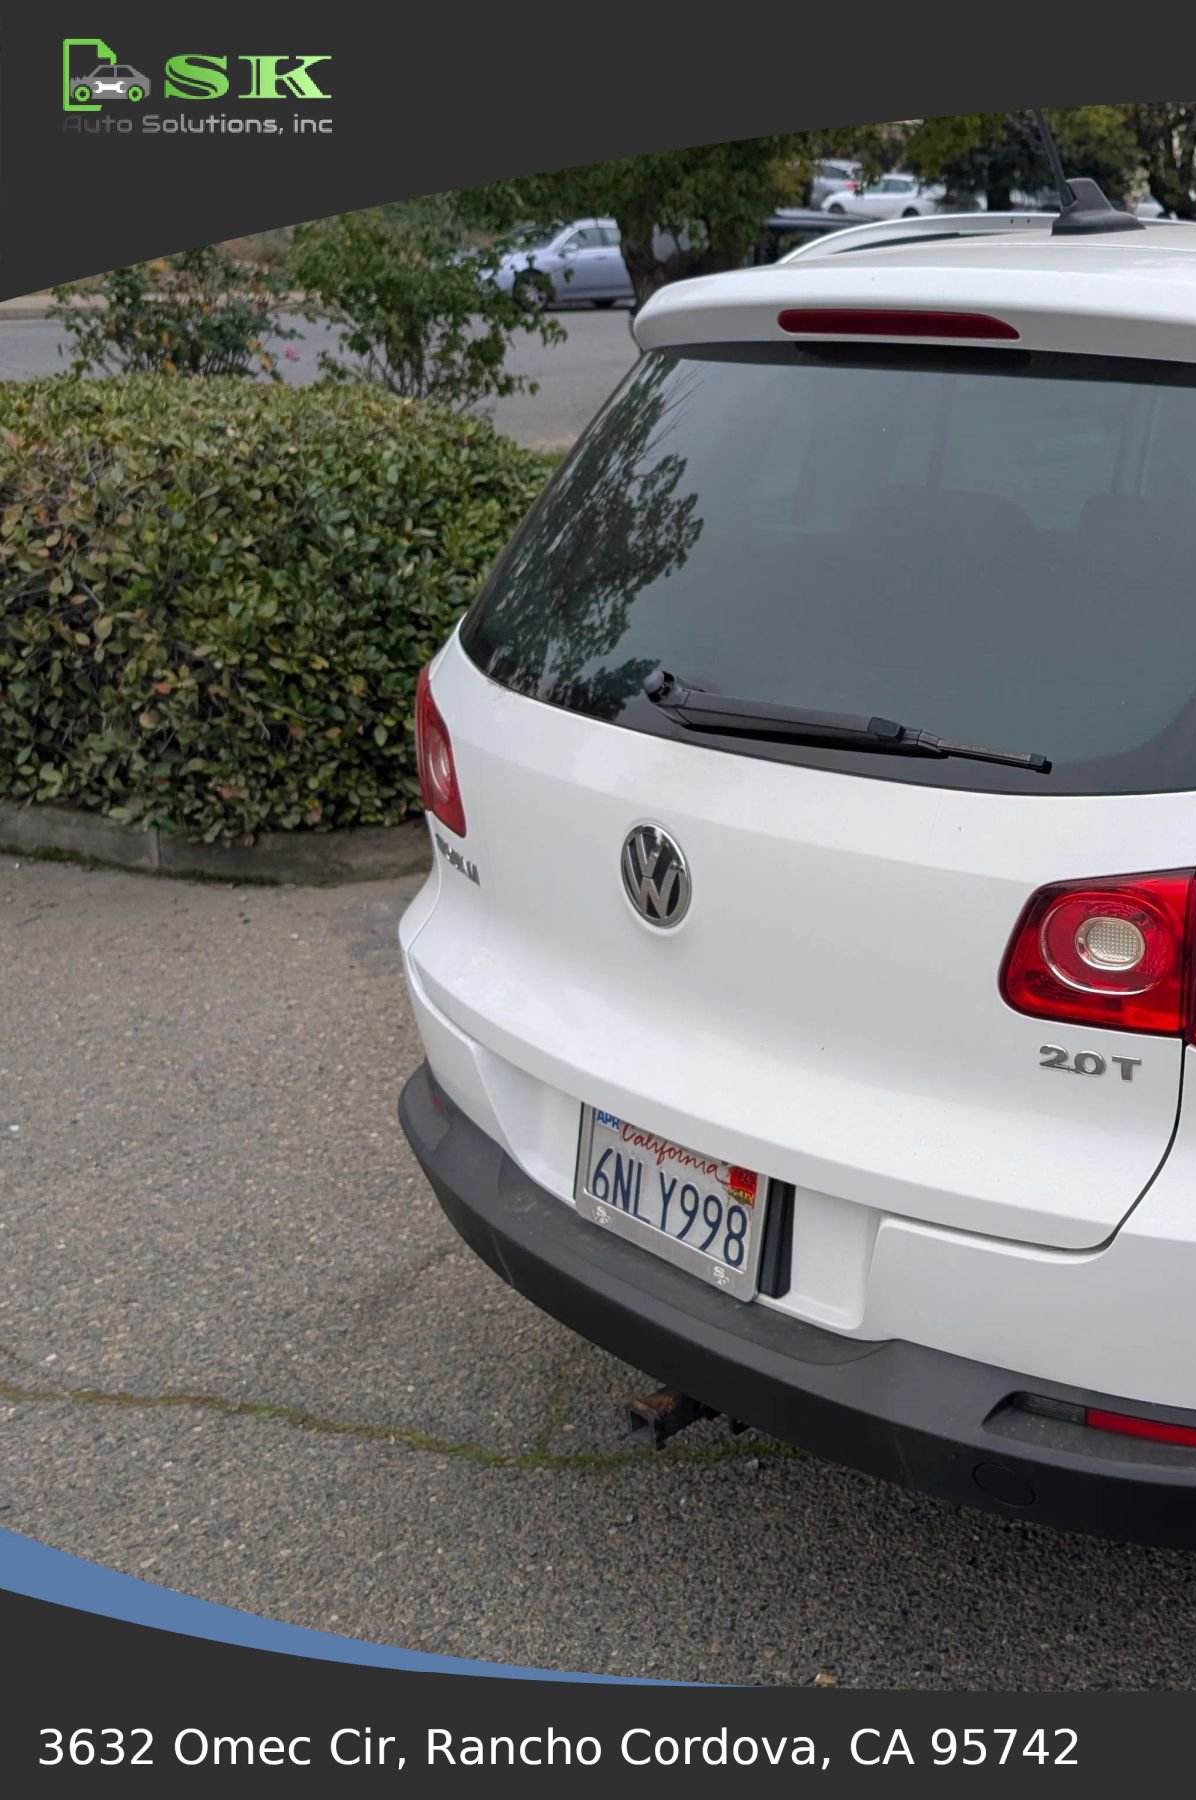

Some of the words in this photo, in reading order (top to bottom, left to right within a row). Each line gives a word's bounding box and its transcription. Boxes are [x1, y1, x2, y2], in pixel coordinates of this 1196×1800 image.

[596, 1110, 620, 1131] APR
[622, 1123, 732, 1187] California
[592, 1147, 748, 1268] 6NLY998
